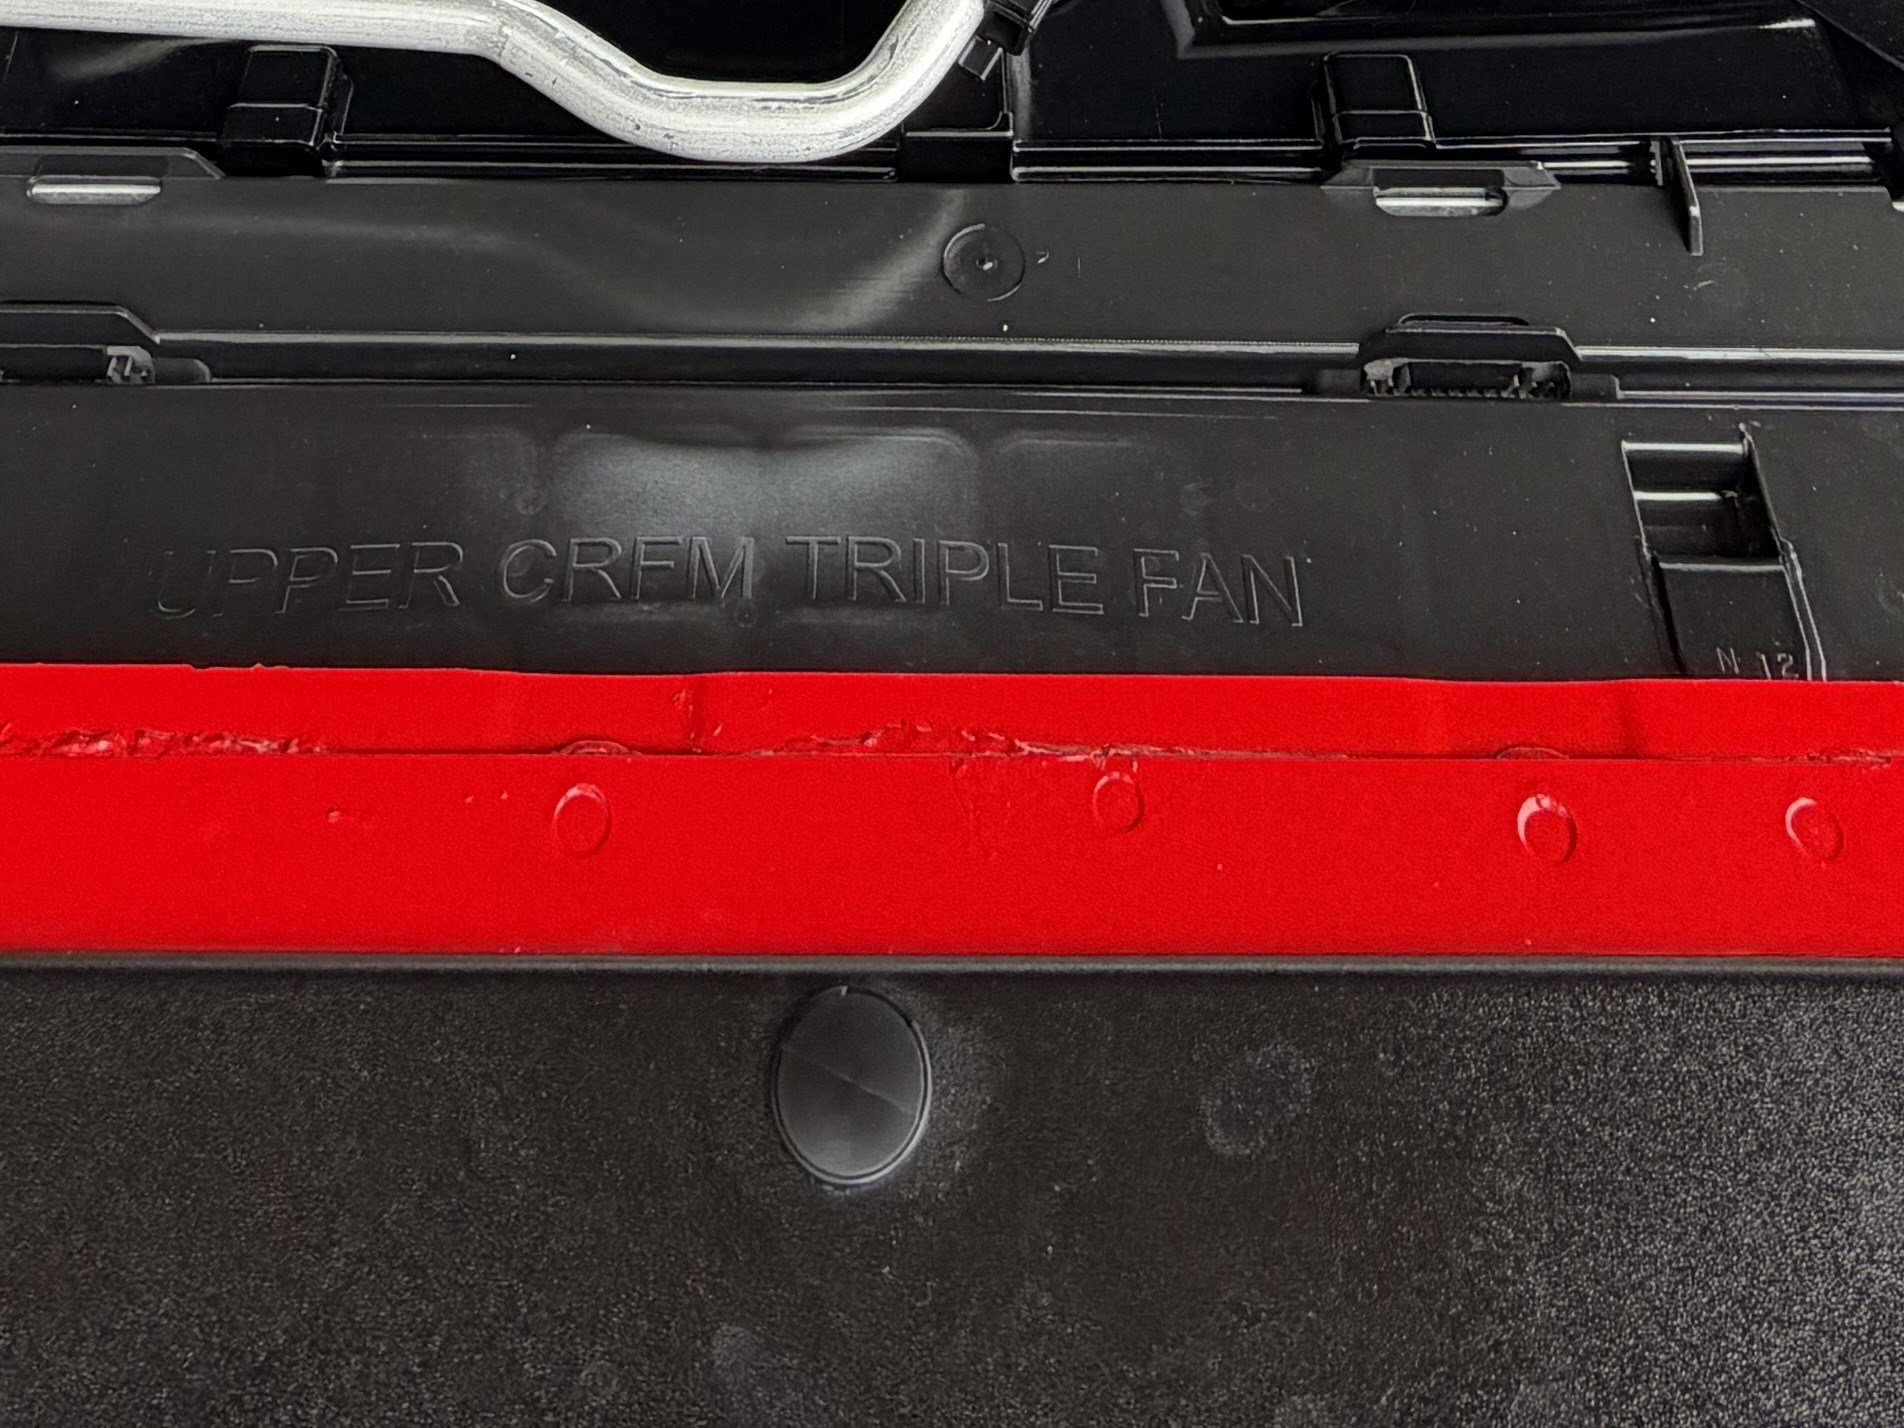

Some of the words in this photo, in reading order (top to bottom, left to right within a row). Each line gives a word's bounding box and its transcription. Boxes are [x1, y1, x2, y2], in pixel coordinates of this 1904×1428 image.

[152, 540, 465, 619] UPPER
[497, 535, 756, 606] CRFM
[784, 535, 1106, 616] TRIPLE
[1131, 547, 1305, 628] FAN
[1755, 651, 1800, 680] 12
